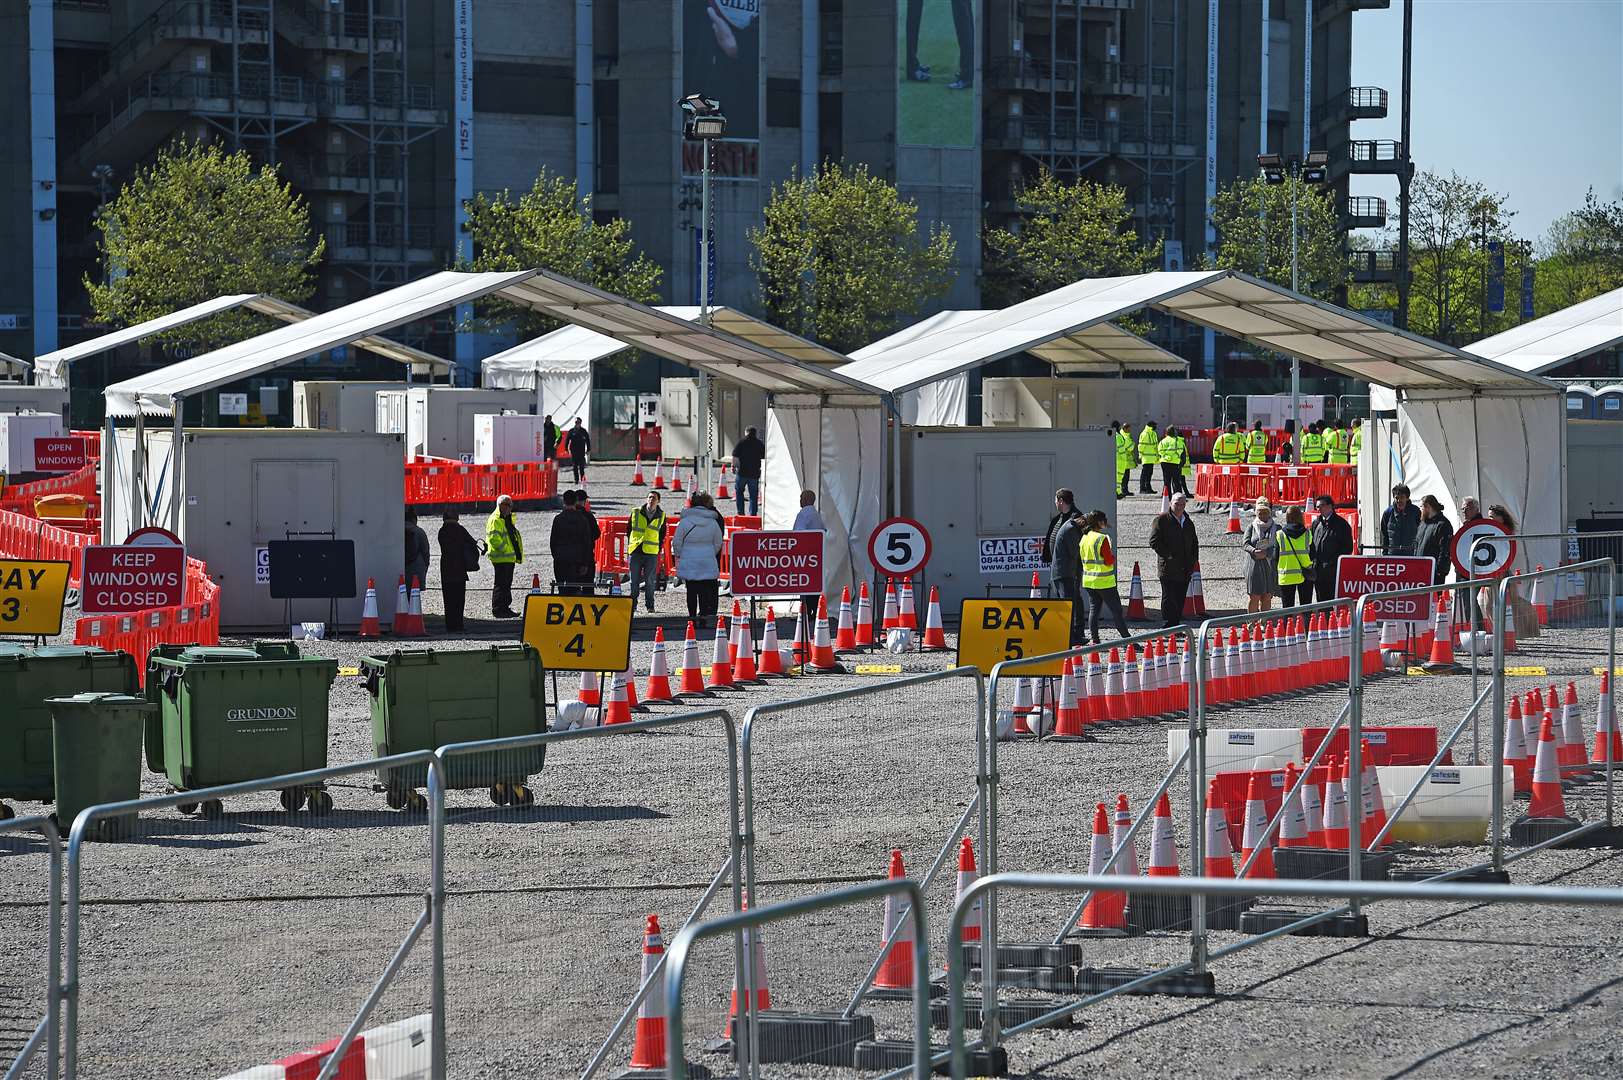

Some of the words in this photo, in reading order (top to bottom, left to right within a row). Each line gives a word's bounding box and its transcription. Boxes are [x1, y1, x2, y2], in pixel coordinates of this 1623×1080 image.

[460, 62, 468, 101] England
[47, 443, 72, 452] OPEN
[37, 456, 83, 465] WINDOWS
[757, 538, 798, 551] KEEP
[886, 532, 912, 566] 5
[981, 539, 1037, 555] GARIC
[1472, 533, 1497, 567] 5
[112, 553, 156, 567] KEEP
[736, 554, 818, 569] WINDOWS
[981, 556, 1005, 564] 0844
[1365, 563, 1406, 577] KEEP
[0, 568, 46, 590] AY
[89, 572, 178, 586] WINDOWS
[744, 573, 810, 588] CLOSED
[96, 591, 168, 606] CLOSED
[1, 597, 20, 622] 3
[545, 603, 609, 626] BAY
[982, 606, 1048, 630] BAY
[564, 633, 586, 658] 4
[1004, 638, 1024, 661] 5
[227, 706, 297, 720] GRUNDON
[1430, 771, 1460, 779] safesite
